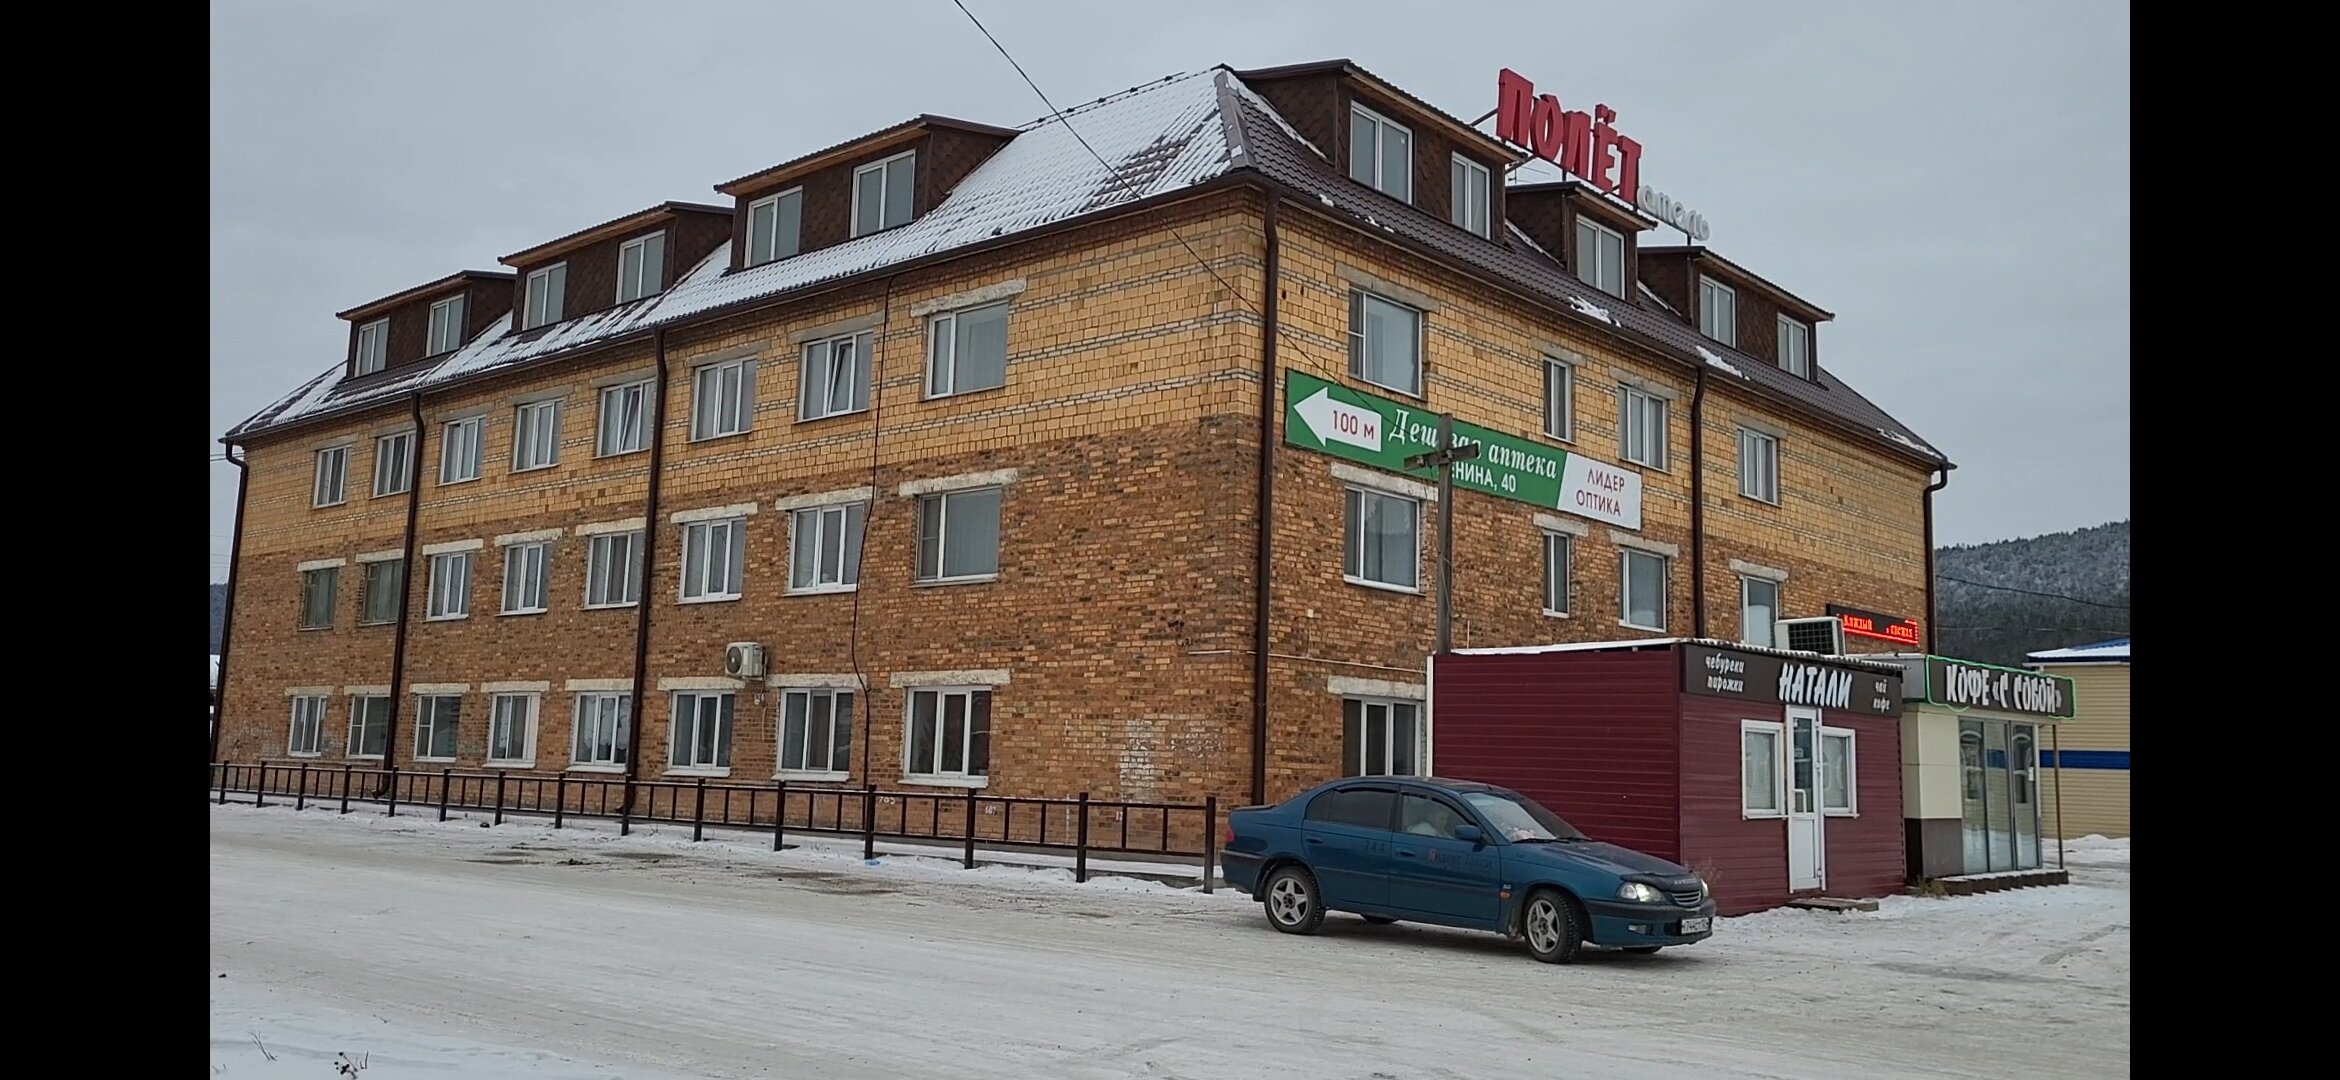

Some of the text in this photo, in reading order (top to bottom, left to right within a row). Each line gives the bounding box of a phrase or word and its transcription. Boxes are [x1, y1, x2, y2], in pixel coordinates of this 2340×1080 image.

[1496, 68, 1642, 205] ПОЛЁТ
[1332, 409, 1359, 436] 100
[1488, 443, 1557, 479] аптека
[1501, 472, 1516, 493] 40
[1587, 467, 1625, 493] ЛИДЕР
[1576, 489, 1621, 517] ОПТИКА
[1705, 652, 1745, 674] чебуреки
[1707, 675, 1744, 693] пирожки
[1779, 662, 1853, 709] НАТАЛИ
[1875, 679, 1887, 693] чай
[1946, 664, 2062, 713] КОФЕ «С СОБОЙ»
[1872, 697, 1890, 713] кофе
